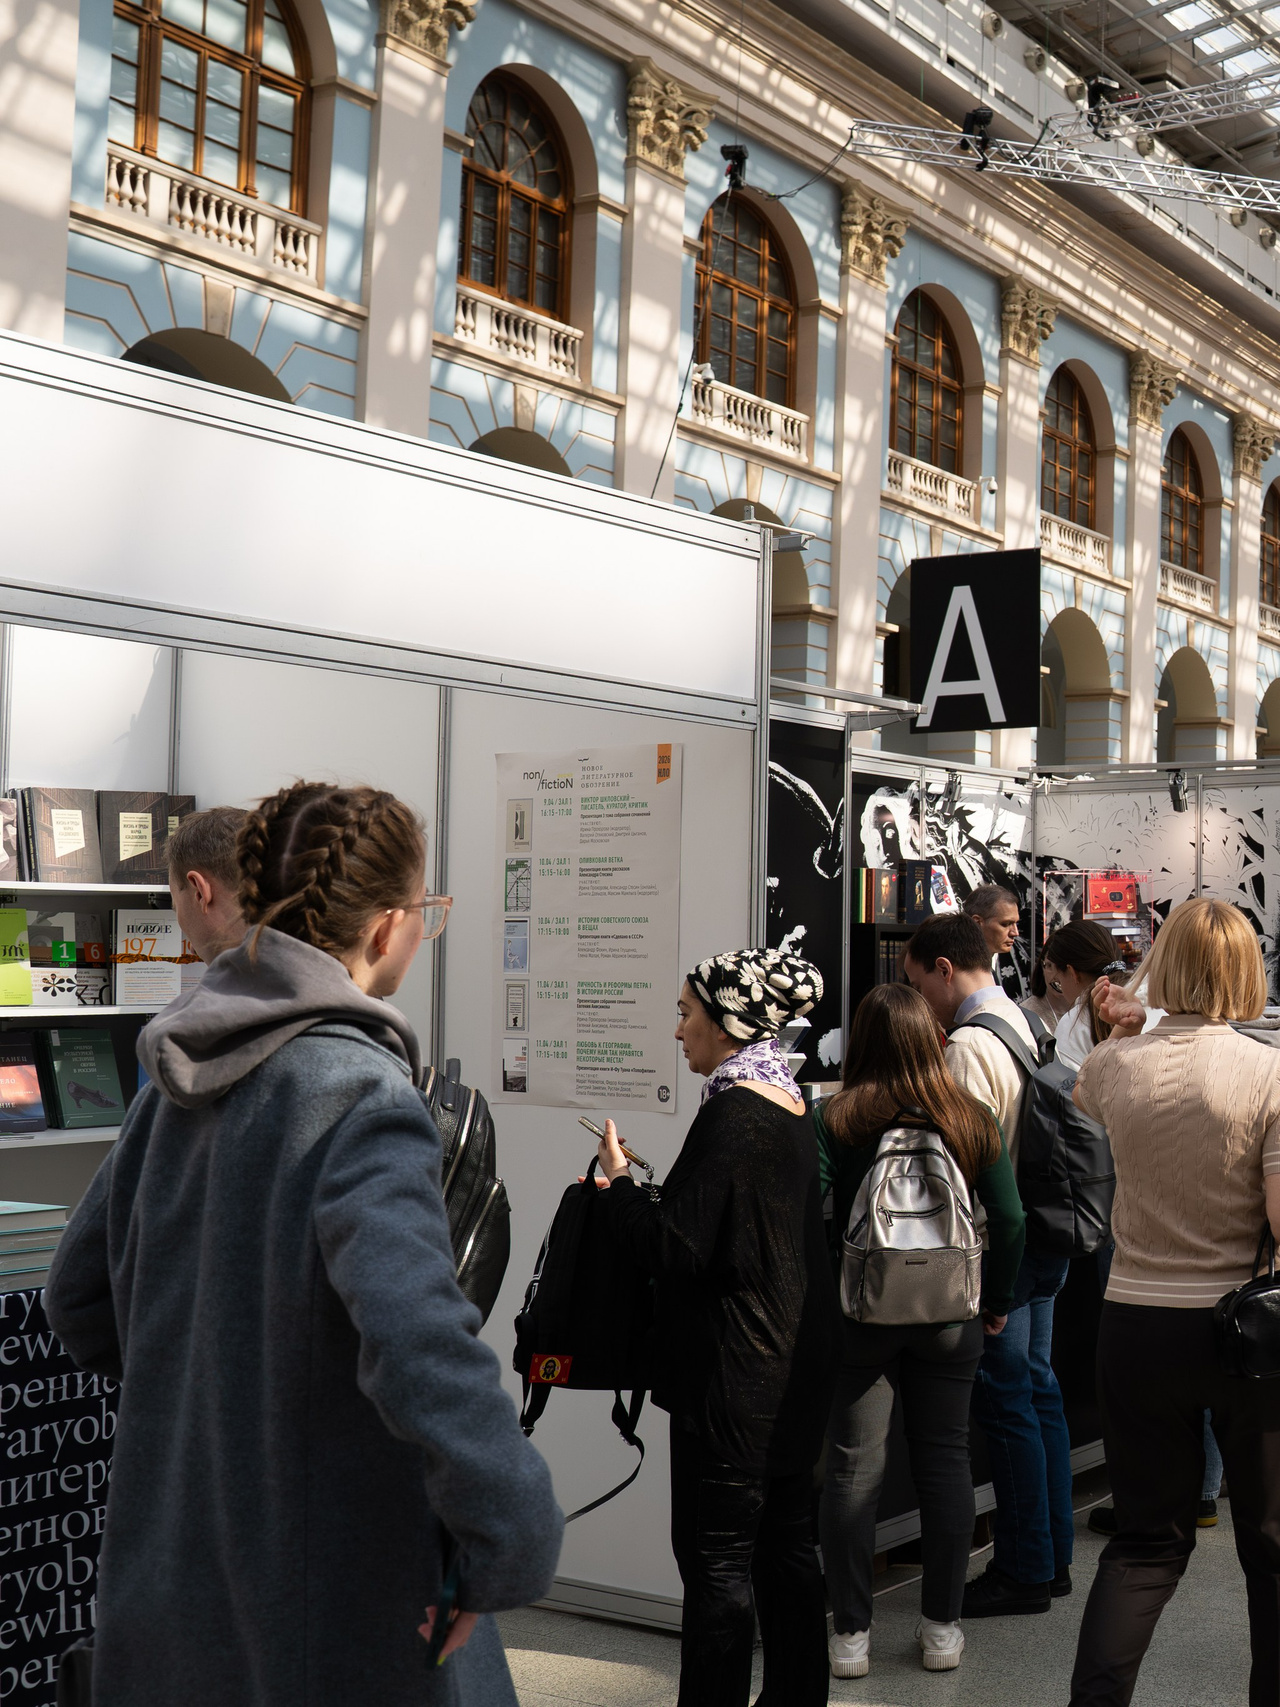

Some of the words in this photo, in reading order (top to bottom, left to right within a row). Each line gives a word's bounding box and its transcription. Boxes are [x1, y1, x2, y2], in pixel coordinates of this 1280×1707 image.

[915, 585, 1006, 727] A
[658, 755, 671, 764] 2026
[580, 771, 634, 780] ЛИТЕРАТУРНОЕ
[657, 768, 671, 778] НЛО
[580, 781, 620, 789] ОБОЗРЕНИЕ
[543, 798, 553, 806] 9.04
[580, 796, 599, 804] ВИКТОР
[599, 794, 630, 803] ШКЛОВСКИЙ
[580, 803, 606, 812] ПИСАТЕЛЬ,
[606, 802, 628, 811] КУРАТОР,
[628, 801, 649, 809] КРИТИК
[539, 858, 551, 866] 10.04
[556, 857, 567, 865] ЗАЛ
[538, 917, 550, 925] 10.04
[555, 917, 566, 925] ЗАЛ
[600, 916, 631, 924] СОВЕТСКОГО
[121, 937, 157, 958] 197
[90, 944, 101, 960] 6
[537, 981, 549, 989] 11.04
[577, 981, 602, 989] ЛИЧНОСТЬ
[536, 1040, 549, 1048] 11.04
[602, 1041, 632, 1049] ГЕОГРАФИИ:
[576, 1048, 597, 1056] ПОЧЕМУ
[606, 1056, 624, 1064] МЕСТА?
